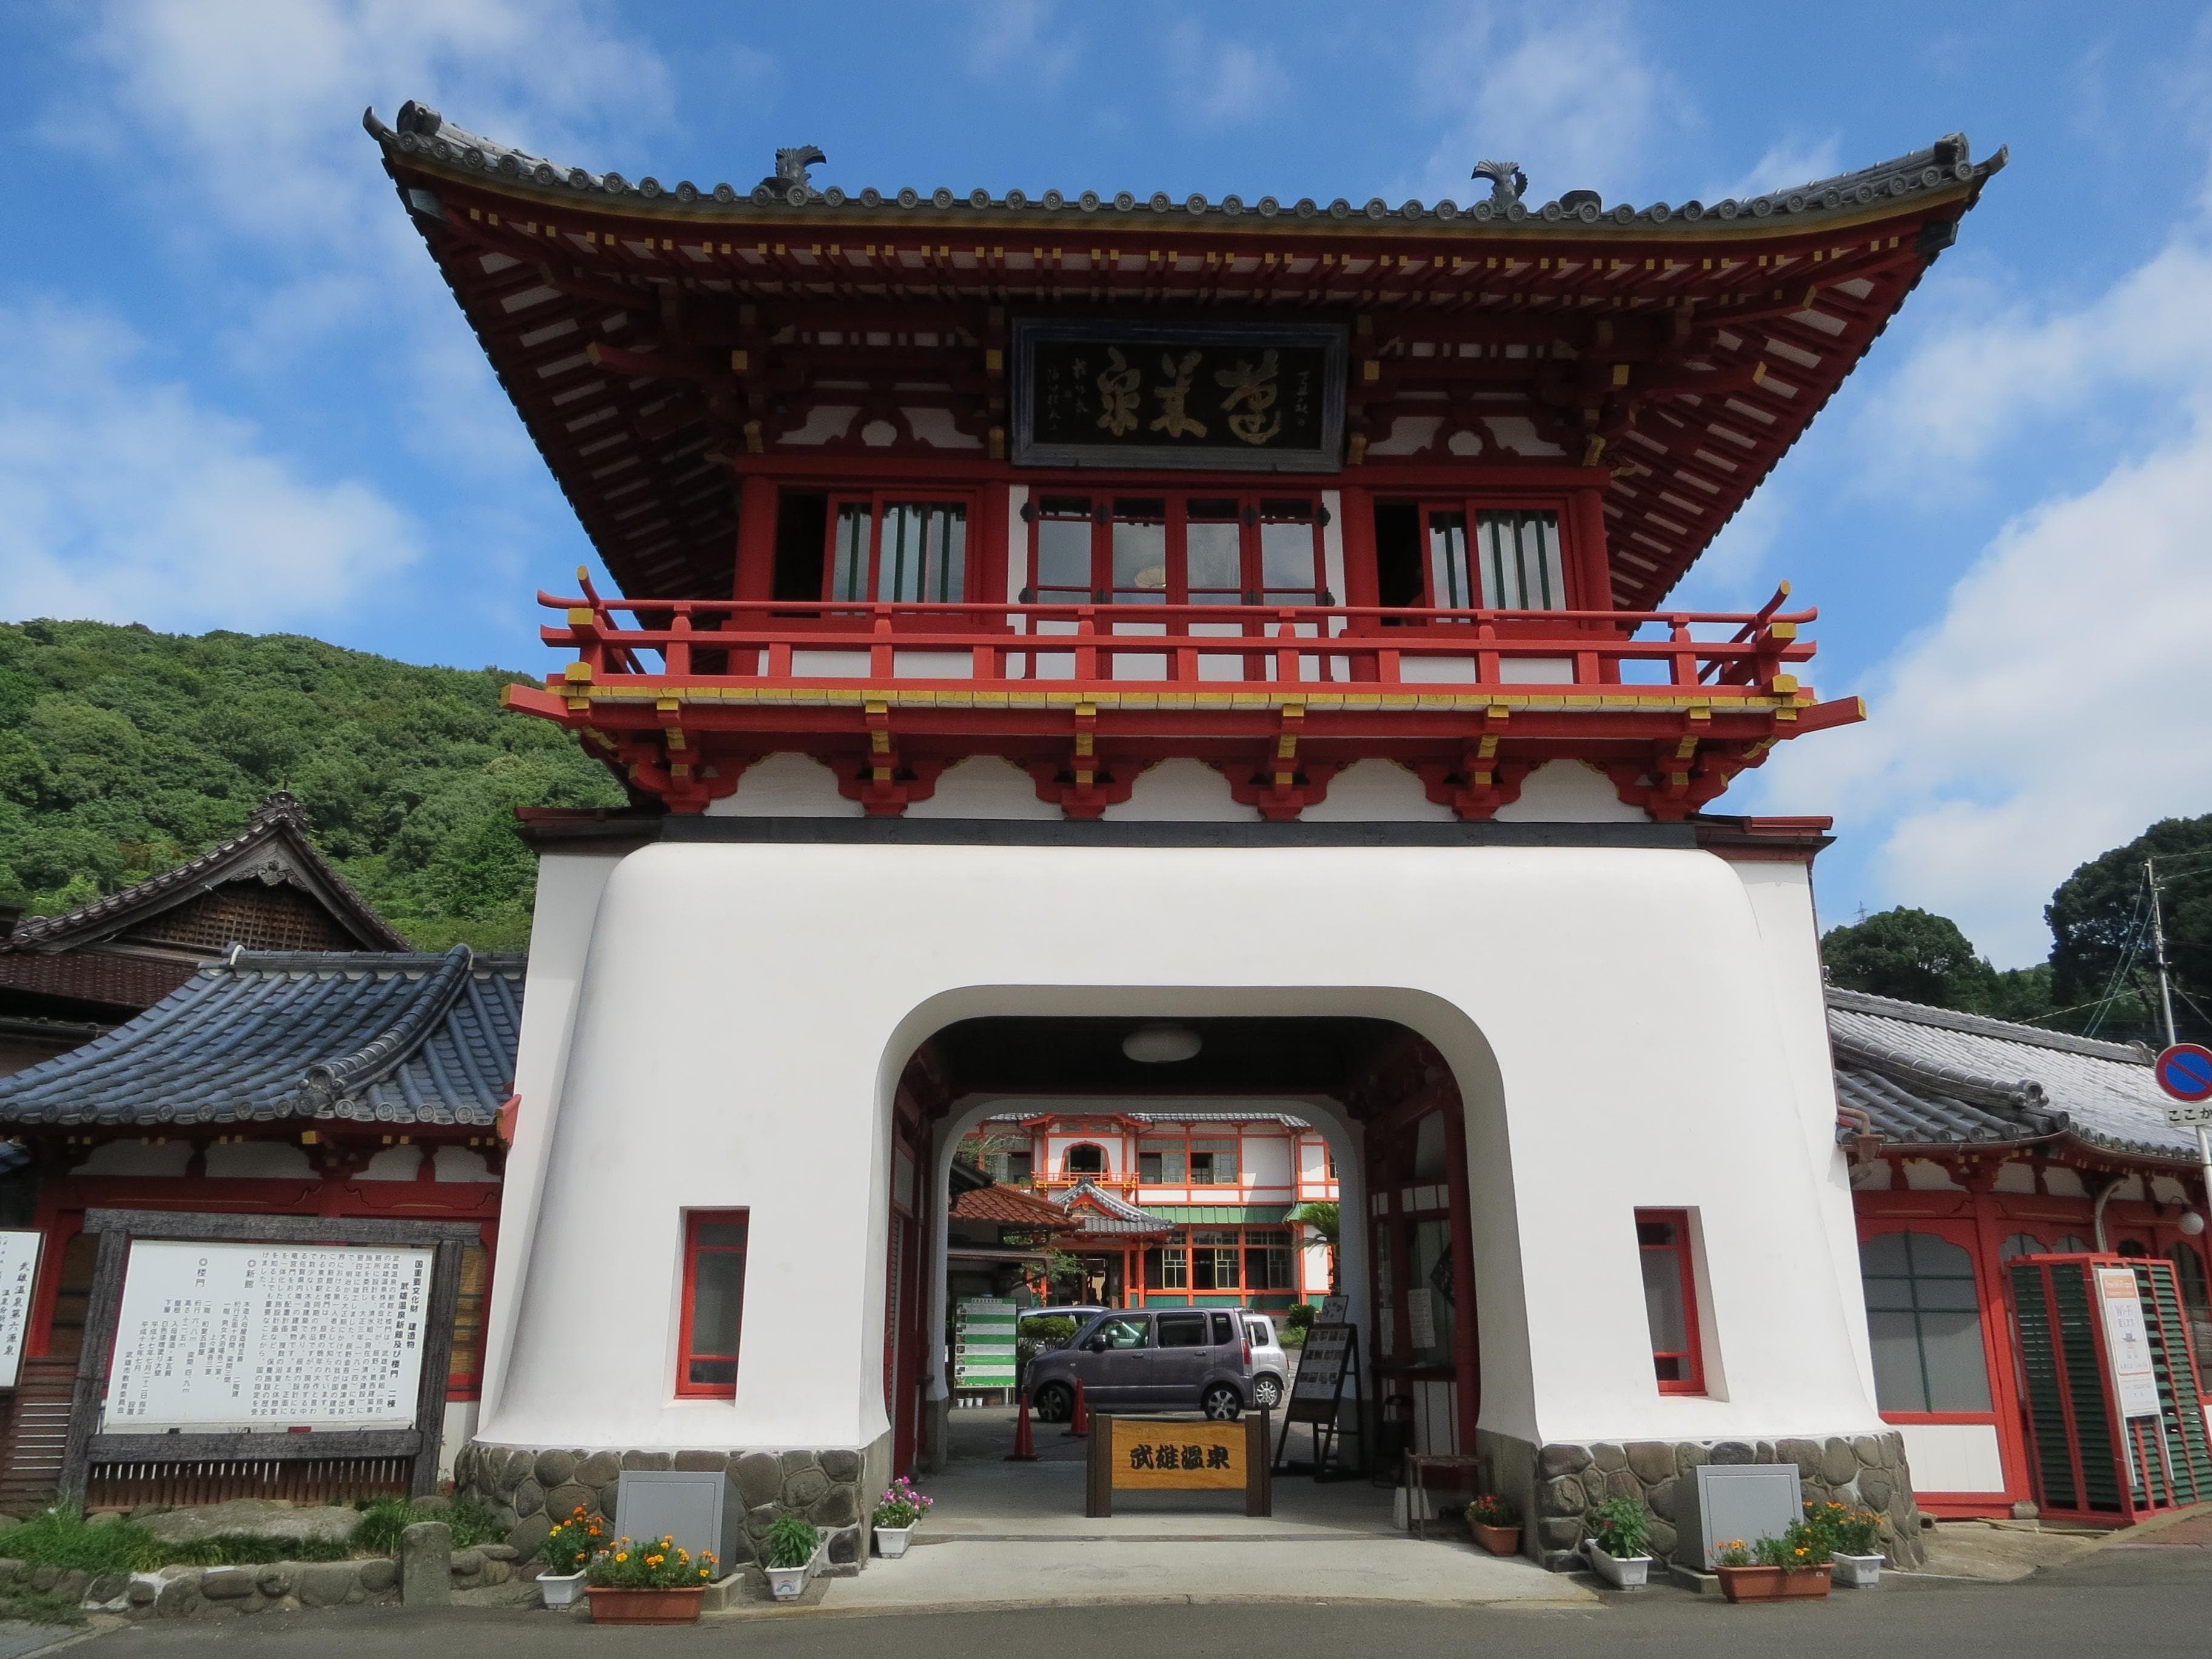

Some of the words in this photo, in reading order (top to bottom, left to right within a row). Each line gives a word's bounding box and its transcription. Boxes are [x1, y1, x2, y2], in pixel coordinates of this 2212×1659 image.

[409, 1259, 423, 1313] 国重要文化財
[390, 1282, 409, 1378] 武雄温泉新館及び楼門
[406, 1322, 417, 1349] 建造物
[386, 1390, 397, 1408] 二棟
[1130, 1444, 1230, 1470] 武雄温泉
